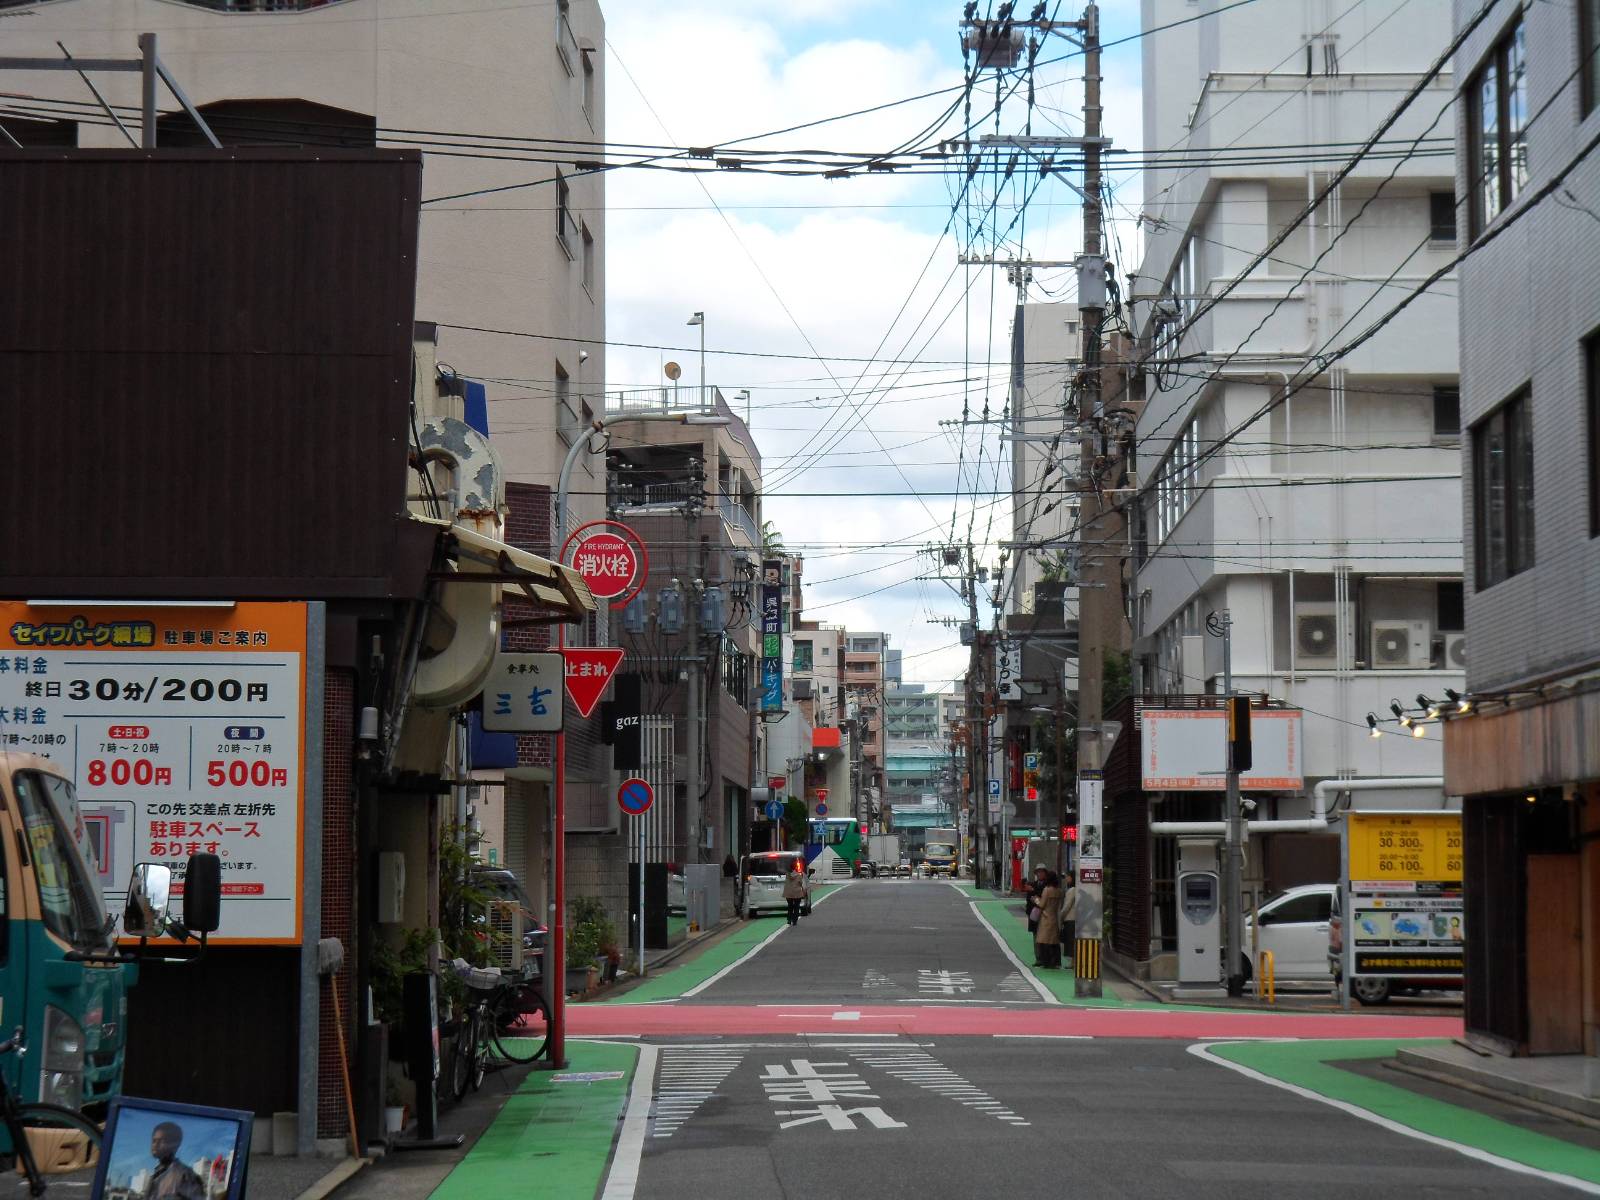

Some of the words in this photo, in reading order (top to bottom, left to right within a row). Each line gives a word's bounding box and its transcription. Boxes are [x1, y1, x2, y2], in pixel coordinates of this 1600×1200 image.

[579, 553, 629, 577] 消火栓
[164, 630, 268, 646] 駐車場ご案内
[0, 656, 48, 674] 本料金
[566, 661, 609, 677] 止まれ
[616, 715, 640, 731] gaz
[231, 728, 259, 738] 夜間
[87, 759, 172, 786] 800円
[207, 760, 287, 787] 500円
[989, 781, 999, 794] P
[149, 821, 261, 838] 駐車スペース
[149, 841, 230, 857] あります。
[759, 1058, 909, 1131] 止まれ
